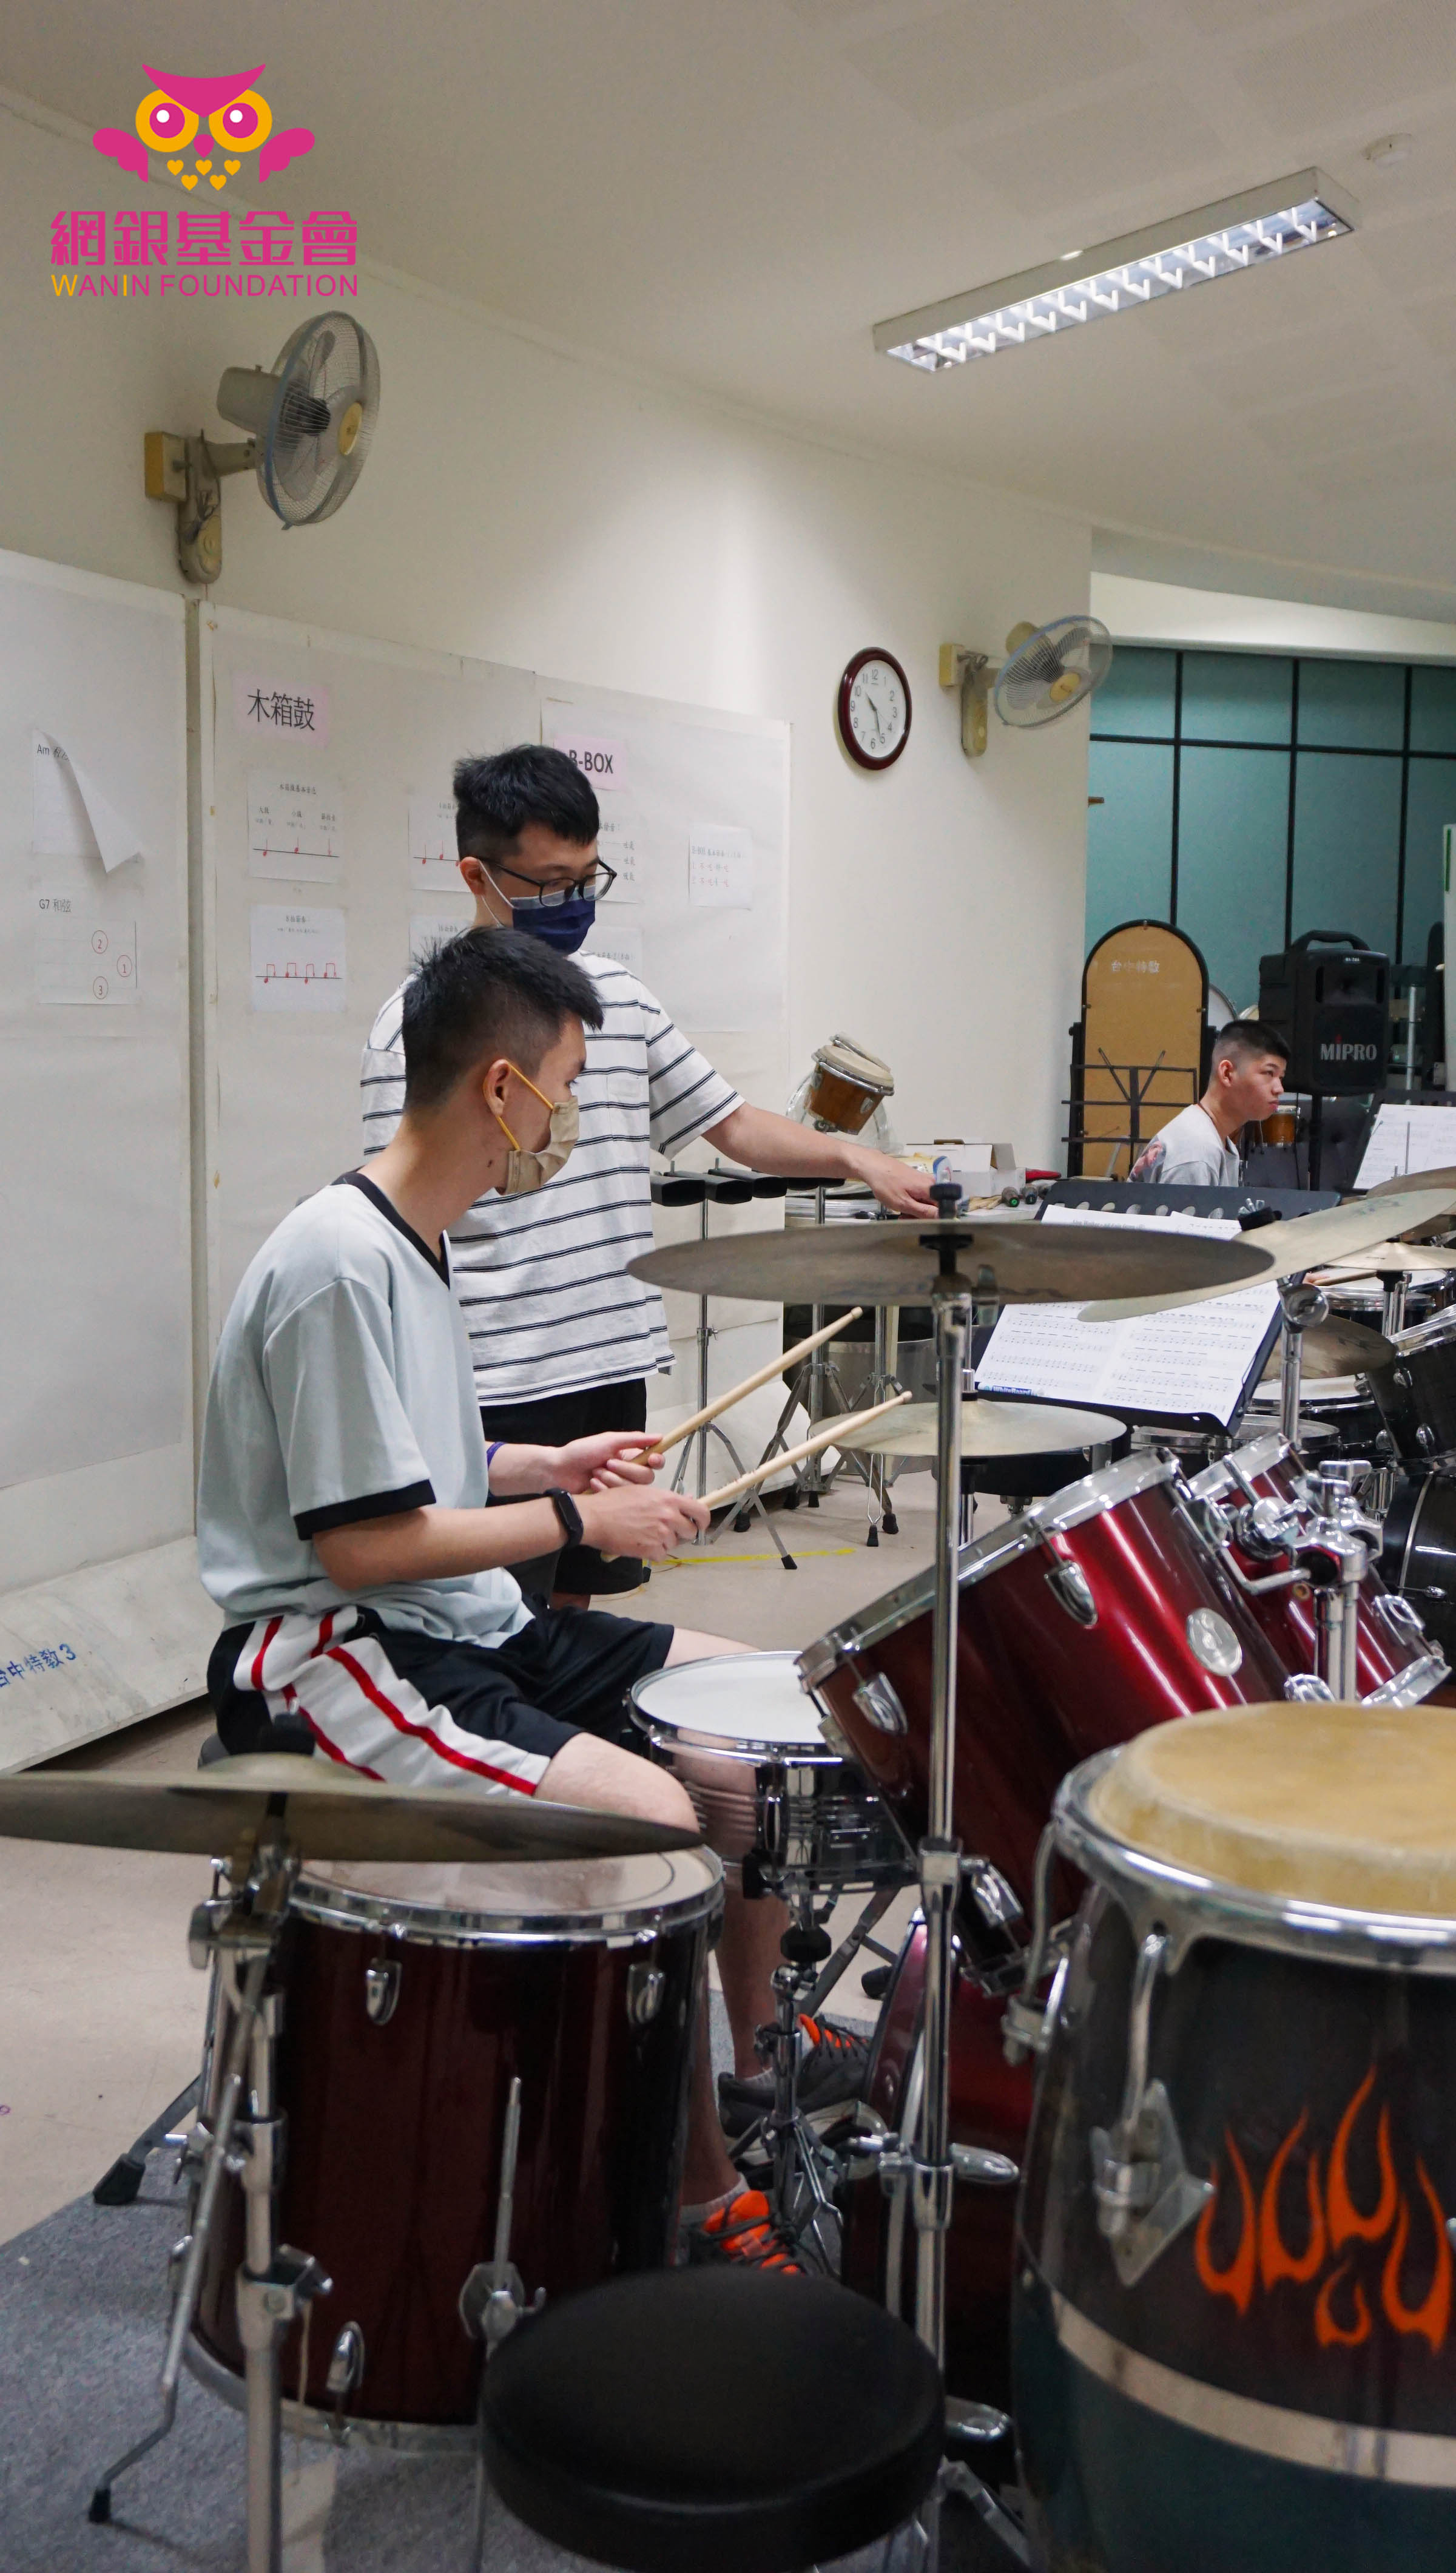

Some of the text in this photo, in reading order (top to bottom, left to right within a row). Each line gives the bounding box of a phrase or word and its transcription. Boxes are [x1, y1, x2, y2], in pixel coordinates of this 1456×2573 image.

[862, 673, 868, 684] 11
[872, 669, 878, 680] 12
[854, 685, 861, 697] 10
[889, 690, 895, 702] 2
[247, 688, 315, 731] 木箱鼓
[851, 700, 855, 712] 9
[853, 717, 858, 729] 8
[871, 738, 875, 749] 6
[37, 744, 50, 756] Am
[39, 898, 72, 913] G7 和弦
[98, 939, 102, 949] 2
[99, 985, 103, 995] 3
